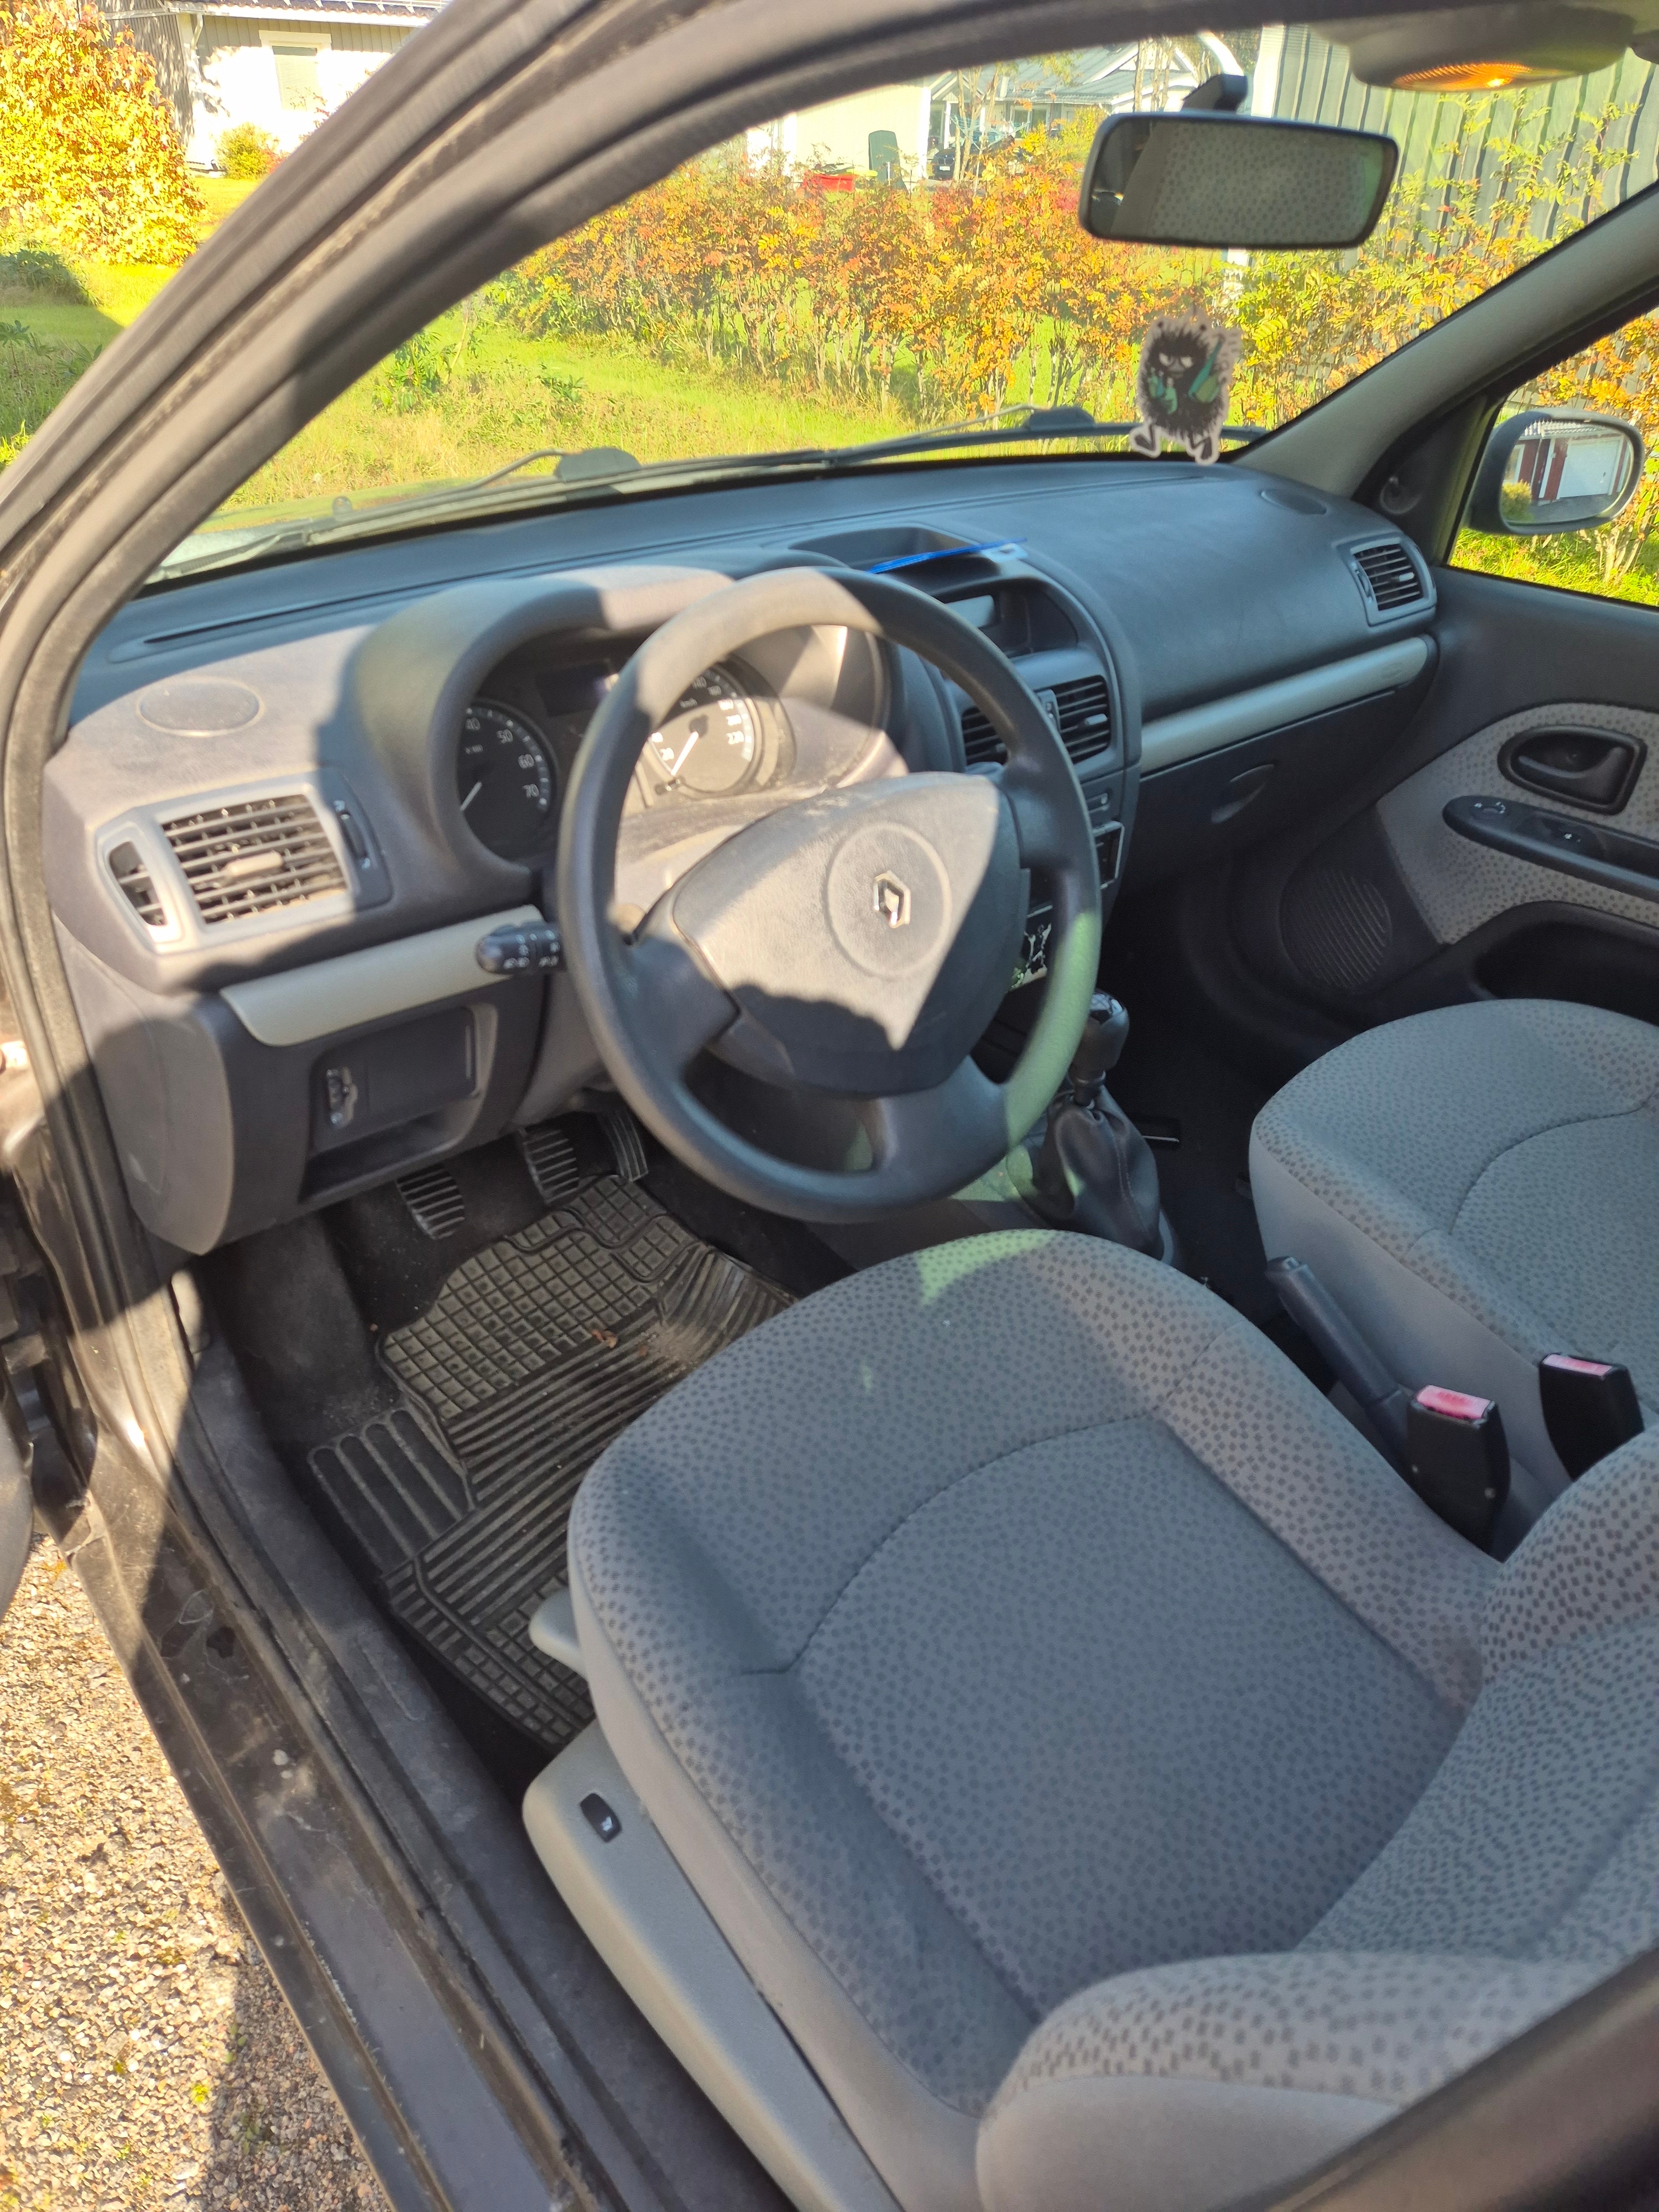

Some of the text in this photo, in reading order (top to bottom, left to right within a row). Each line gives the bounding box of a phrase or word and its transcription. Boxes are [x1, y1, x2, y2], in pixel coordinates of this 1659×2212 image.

[497, 729, 514, 744] 50
[518, 754, 535, 769] 60
[523, 784, 540, 798] 70
